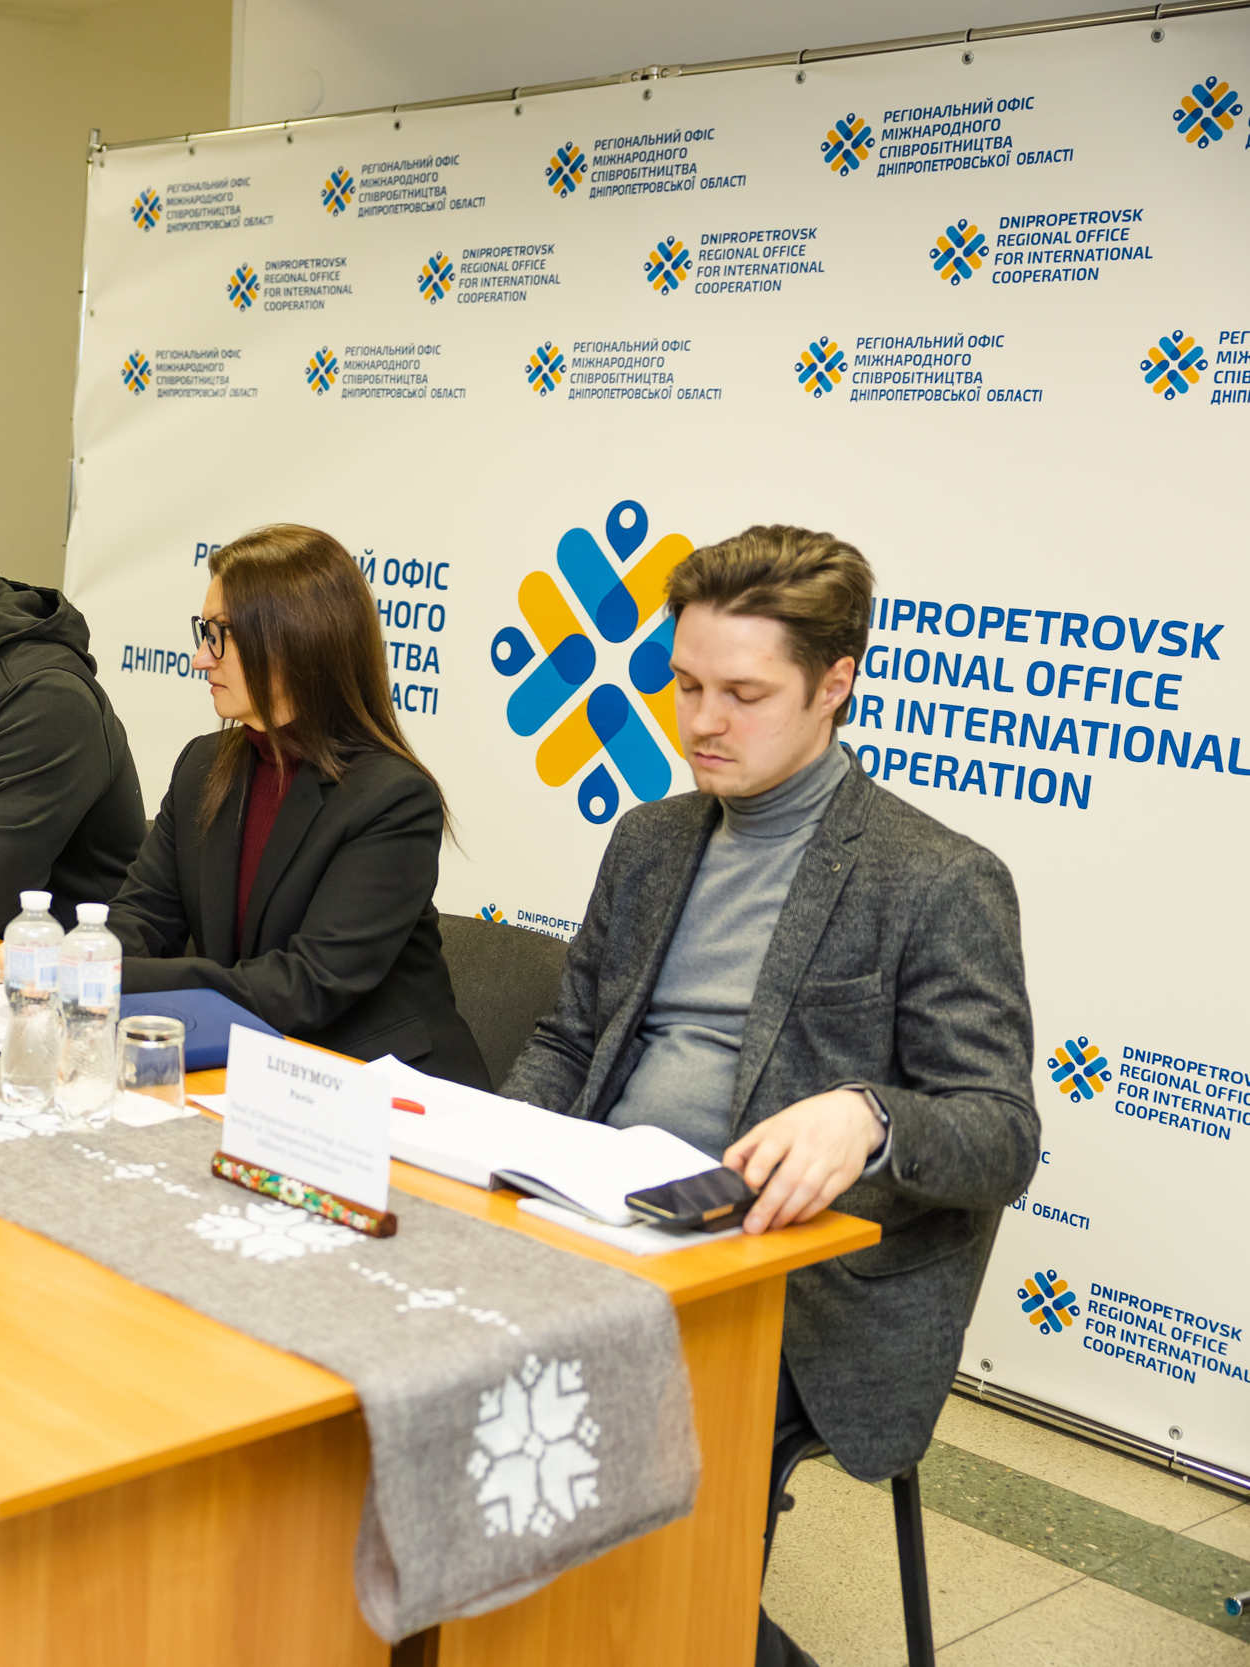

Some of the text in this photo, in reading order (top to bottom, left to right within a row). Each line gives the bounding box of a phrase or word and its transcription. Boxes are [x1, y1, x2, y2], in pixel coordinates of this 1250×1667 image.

[883, 97, 1035, 124] РЕГІОНАЛЬНИЙ ОФІС
[881, 118, 1001, 141] МІЖНАРОДНОГО
[594, 129, 714, 151] РЕГІОНАЛЬНИЙ ОФІС
[879, 136, 1013, 158] СПІВРОБІТНИЦТВА
[361, 155, 460, 174] РЕГІОНАЛЬНИЙ ОФІС
[593, 147, 688, 166] МІЖНАРОДНОГО
[877, 149, 1074, 177] ДНІПРОПЕТРОВСЬКОЇ ОБЛАСТІ
[360, 172, 439, 188] МІЖНАРОДНОГО
[591, 163, 697, 182] СПІВРОБІТНИЦТВА
[167, 176, 251, 193] РЕГІОНАЛЬНИЙ ОФІС
[589, 175, 746, 199] ДНІПРОПЕТРОВСЬКОЇ ОБЛАСТІ
[166, 192, 233, 206] МІЖНАРОДНОГО
[359, 186, 447, 203] СПІВРОБІТНИЦТВА
[166, 206, 241, 219] СПІВРОБІТНИЦТВА
[357, 197, 485, 218] ДНІПРОПЕТРОВСЬКОЇ ОБЛАСТІ
[166, 215, 273, 233] ДНІПРОПЕТРОВСЬКОЇ ОБЛАСТІ
[999, 208, 1144, 229] DNIPROPETROVSK
[701, 228, 817, 245] DNIPROPETROVSK
[997, 228, 1130, 247] REGIONAL OFFICE
[462, 244, 555, 259] DNIPROPETROVSK
[699, 245, 806, 260] REGIONAL OFFICE
[994, 246, 1153, 265] FOR INTERNATIONAL
[265, 256, 347, 270] DNIPROPETROVSK
[460, 259, 546, 274] REGIONAL OFFICE
[697, 261, 825, 277] FOR INTERNATIONAL
[264, 270, 340, 283] REGIONAL OFFICE
[459, 274, 561, 289] FOR INTERNATIONAL
[992, 267, 1099, 284] COOPERATION
[264, 284, 353, 297] FOR INTERNATIONAL
[695, 280, 781, 294] COOPERATION
[264, 299, 325, 311] COOPERATION
[457, 291, 527, 304] COOPERATION
[345, 343, 441, 356] РЕГІОНАЛЬНИЙ ОФІС
[573, 339, 691, 352] РЕГІОНАЛЬНИЙ ОФІС
[856, 333, 1004, 350] РЕГІОНАЛЬНИЙ ОФІС
[156, 349, 241, 359] РЕГІОНАЛЬНИЙ ОФІС
[572, 356, 664, 368] МІЖНАРОДНОГО
[854, 353, 972, 367] МІЖНАРОДНОГО
[156, 362, 225, 373] МІЖНАРОДНОГО
[343, 359, 420, 370] МІЖНАРОДНОГО
[156, 375, 230, 385] СПІВРОБІТНИЦТВА
[342, 374, 428, 384] СПІВРОБІТНИЦТВА
[570, 373, 674, 385] СПІВРОБІТНИЦТВА
[852, 372, 983, 385] СПІВРОБІТНИЦТВА
[157, 386, 258, 398] ДНІПРОПЕТРОВСЬКОЇ ОБЛАСТІ
[341, 384, 466, 399] ДНІПРОПЕТРОВСЬКОЇ ОБЛАСТІ
[568, 386, 722, 400] ДНІПРОПЕТРОВСЬКОЇ ОБЛАСТІ
[850, 386, 1043, 402] ДНІПРОПЕТРОВСЬКОЇ ОБЛАСТІ
[383, 558, 450, 590] ОФІС
[869, 597, 1225, 661] IPROPETROVSK
[856, 645, 1183, 710] GIONAL OFFICE
[391, 682, 438, 714] АСТІ
[894, 698, 1250, 776] INTERNATIONAL
[846, 741, 1092, 810] OPERATION
[1120, 1064, 1250, 1106] REGIONAL OFFIC
[1118, 1082, 1250, 1126] FOR INTERNATIO
[1115, 1100, 1231, 1140] COOPERATION
[1032, 1203, 1090, 1230] ОБЛАСТІ
[1091, 1283, 1242, 1341] DNIPROPETROVSK
[1088, 1300, 1228, 1356] REGIONAL OFFICE
[1085, 1318, 1250, 1383] FOR INTERNATIONAL
[1083, 1336, 1196, 1384] COOPERATION
